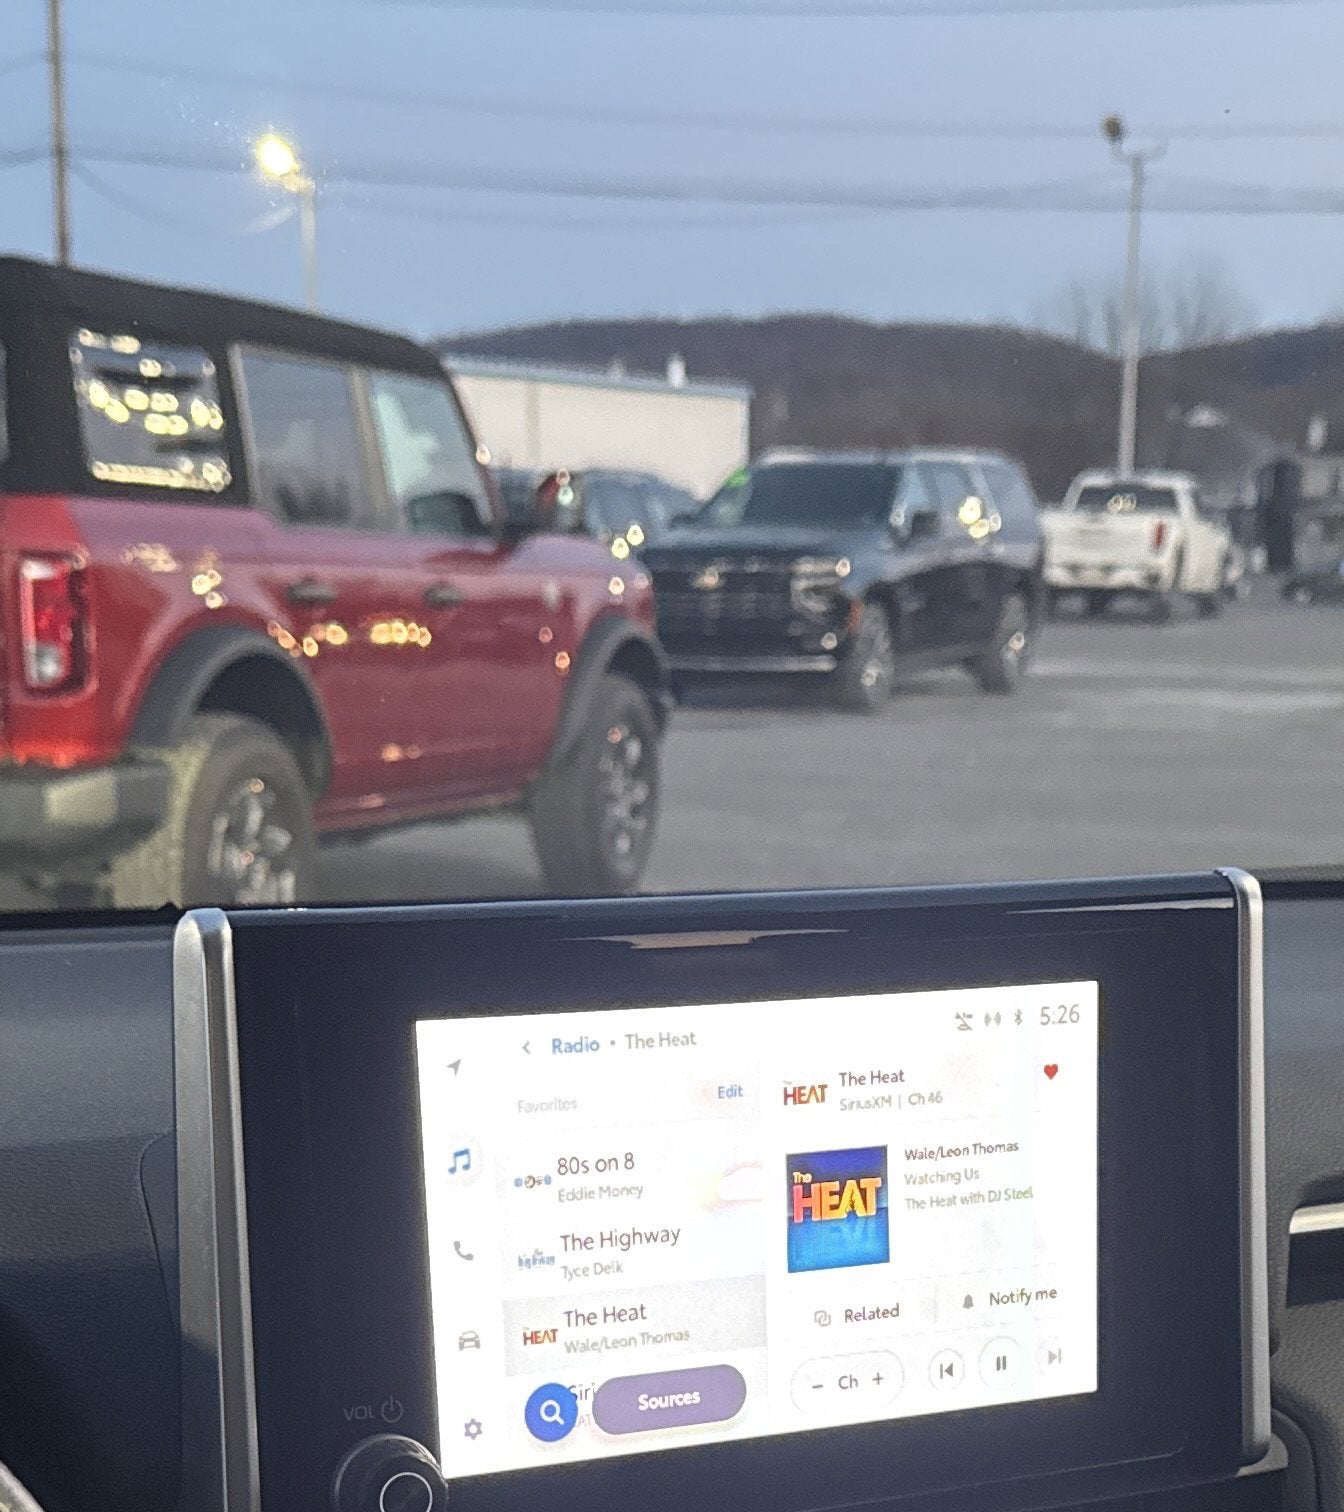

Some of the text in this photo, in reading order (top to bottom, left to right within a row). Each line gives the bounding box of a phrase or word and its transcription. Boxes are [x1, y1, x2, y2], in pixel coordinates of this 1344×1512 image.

[1040, 1004, 1080, 1025] 5:26
[551, 1031, 697, 1055] Radio The Heat
[839, 1070, 905, 1087] The Heat
[717, 1084, 743, 1099] Edit
[783, 1084, 828, 1105] HEAT
[517, 1097, 577, 1113] Favorites
[840, 1095, 892, 1111] SiriusXM
[908, 1093, 925, 1106] Ch
[905, 1142, 1019, 1161] Wale/Leon Thomas
[557, 1152, 635, 1176] 80s on 8
[904, 1167, 980, 1186] Watching Us
[558, 1183, 643, 1203] Eddie Money
[793, 1177, 881, 1223] HEAT
[905, 1197, 927, 1210] The
[929, 1195, 958, 1209] Heat
[960, 1192, 985, 1206] with
[560, 1227, 681, 1252] The Highway
[990, 1287, 1058, 1307] Notify me
[564, 1303, 647, 1327] The Heat
[845, 1303, 900, 1323] Related
[523, 1328, 558, 1346] HEAT
[564, 1330, 690, 1354] Wale/Leon Thomas
[838, 1374, 858, 1390] Ch
[638, 1391, 700, 1411] Sources
[343, 1404, 376, 1421] VOL
